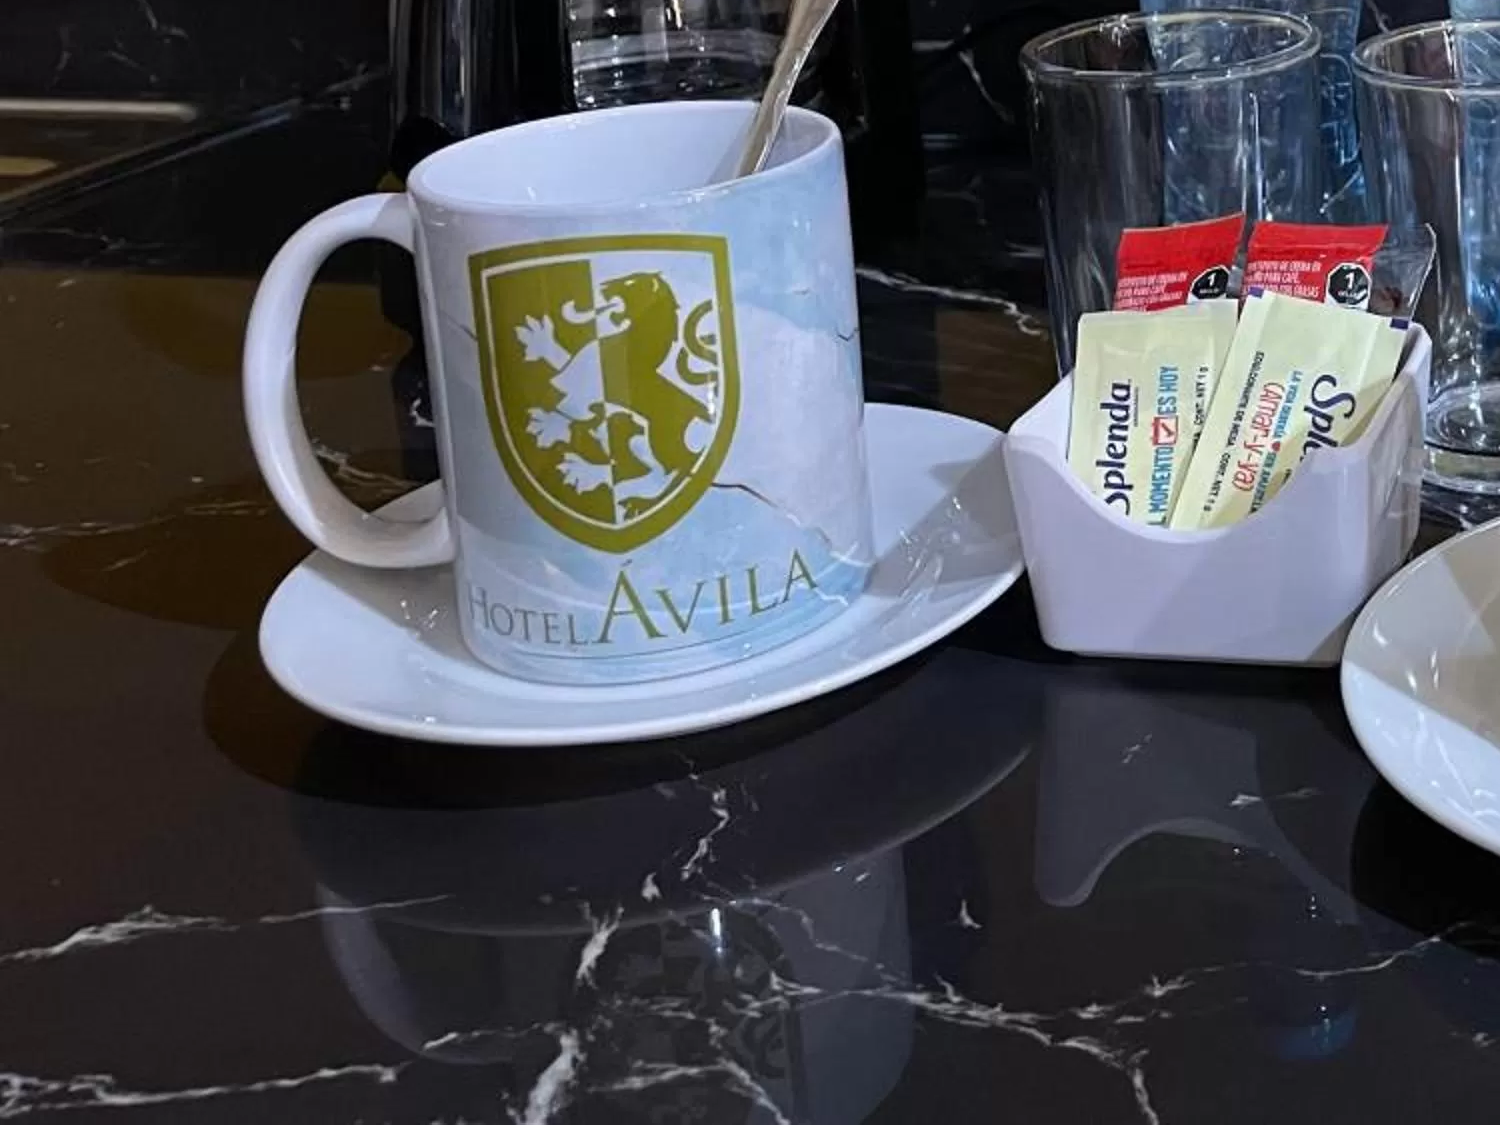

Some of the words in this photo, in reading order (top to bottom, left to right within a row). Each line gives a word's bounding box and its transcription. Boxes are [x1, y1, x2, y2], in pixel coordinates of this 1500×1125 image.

[1207, 273, 1217, 287] 1
[1345, 272, 1356, 289] 1
[1158, 366, 1179, 393] HOY
[1158, 396, 1177, 415] ES
[1231, 382, 1286, 492] (Amar-y-ya)
[1148, 447, 1174, 513] MOMENTO
[467, 581, 592, 646] HOTEL
[592, 548, 820, 644] ÁVILA
